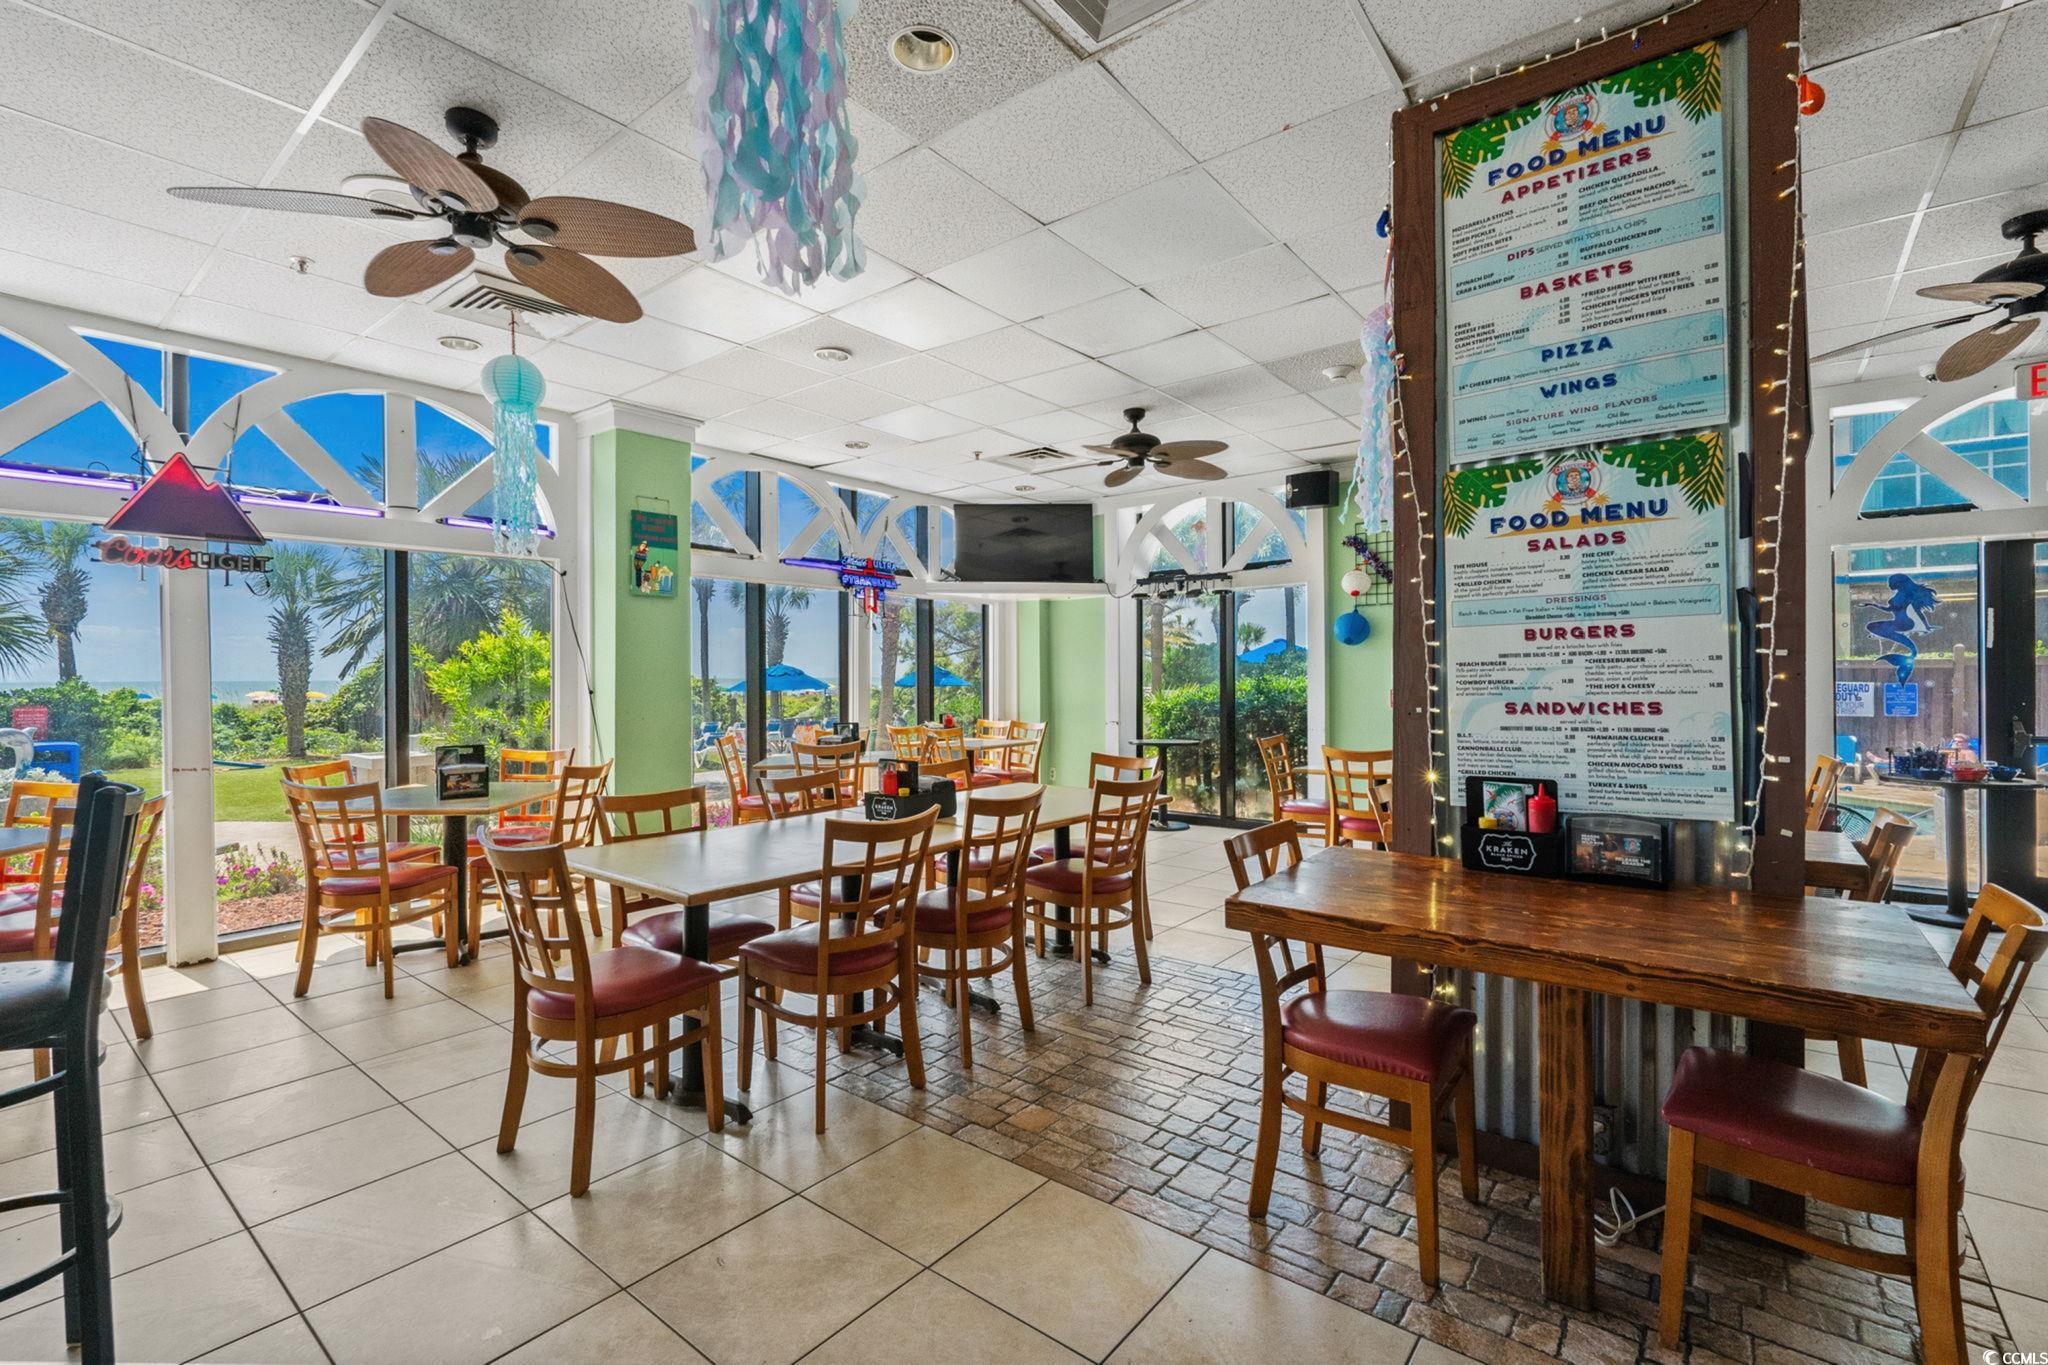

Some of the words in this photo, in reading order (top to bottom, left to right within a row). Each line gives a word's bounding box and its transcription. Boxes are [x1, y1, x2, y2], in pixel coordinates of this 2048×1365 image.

[1487, 145, 1566, 188] FOOD
[1578, 113, 1665, 159] MENU
[1500, 145, 1652, 205] APPETIZERS
[1578, 178, 1610, 193] CHICKEN
[1611, 164, 1658, 184] QUESADILLA
[1578, 200, 1596, 211] BEEF
[1597, 197, 1608, 206] OR
[1609, 187, 1642, 202] CHICKEN
[1643, 177, 1676, 193] NACHOS
[1452, 216, 1490, 233] MOZZARELLA
[1491, 208, 1513, 221] STICKS
[1452, 235, 1470, 246] FRIED
[1471, 227, 1495, 240] PICKLES
[1452, 248, 1468, 258] SOFT
[1468, 241, 1493, 253] PRETZEL
[1494, 235, 1512, 245] BITES
[1507, 247, 1534, 262] DIPS
[1536, 240, 1562, 254] SERVED
[1564, 234, 1583, 246] WITH
[1586, 224, 1622, 240] TORTILLA
[1623, 217, 1647, 230] CHIPS
[1579, 239, 1612, 253] BUFFALO
[1613, 230, 1646, 244] CHICKEN
[1648, 226, 1661, 235] DIP
[1455, 275, 1482, 288] SPINACH
[1483, 272, 1494, 280] DIP
[1519, 258, 1633, 300] BASKETS
[1454, 321, 1471, 330] FRIES
[1454, 326, 1476, 337] CHEESE
[1477, 321, 1494, 331] FRIES
[1586, 321, 1601, 330] HOT
[1603, 316, 1623, 327] DOGS
[1624, 312, 1644, 322] WITH
[1646, 307, 1667, 317] FRIES
[1454, 332, 1475, 343] ONION
[1476, 328, 1495, 338] RINGS
[1454, 340, 1470, 350] CLAM
[1471, 335, 1492, 346] STRIPS
[1493, 330, 1510, 340] WITH
[1511, 326, 1529, 336] FRIES
[1541, 334, 1613, 363] PIZZA
[1469, 379, 1492, 388] CHEESE
[1493, 375, 1510, 384] PIZZA
[1539, 371, 1617, 400] WINGS
[1466, 414, 1487, 424] WINGS
[1506, 410, 1563, 426] SIGNATURE
[1569, 404, 1598, 416] WING
[1605, 393, 1657, 410] FLAVORS
[1489, 508, 1569, 535] FOOD
[1580, 497, 1668, 525] MENU
[1526, 530, 1626, 553] SALADS
[102, 536, 192, 571] Coors
[196, 551, 270, 573] LIGHT
[1582, 569, 1613, 577] CHICKEN
[1614, 567, 1643, 575] CAESAR
[1545, 593, 1606, 604] DRESSINGS
[1524, 623, 1635, 641] BURGERS
[1837, 683, 1870, 692] EGUARD
[1504, 701, 1663, 716] SANDWICHES
[1486, 845, 1528, 855] KRAKEN
